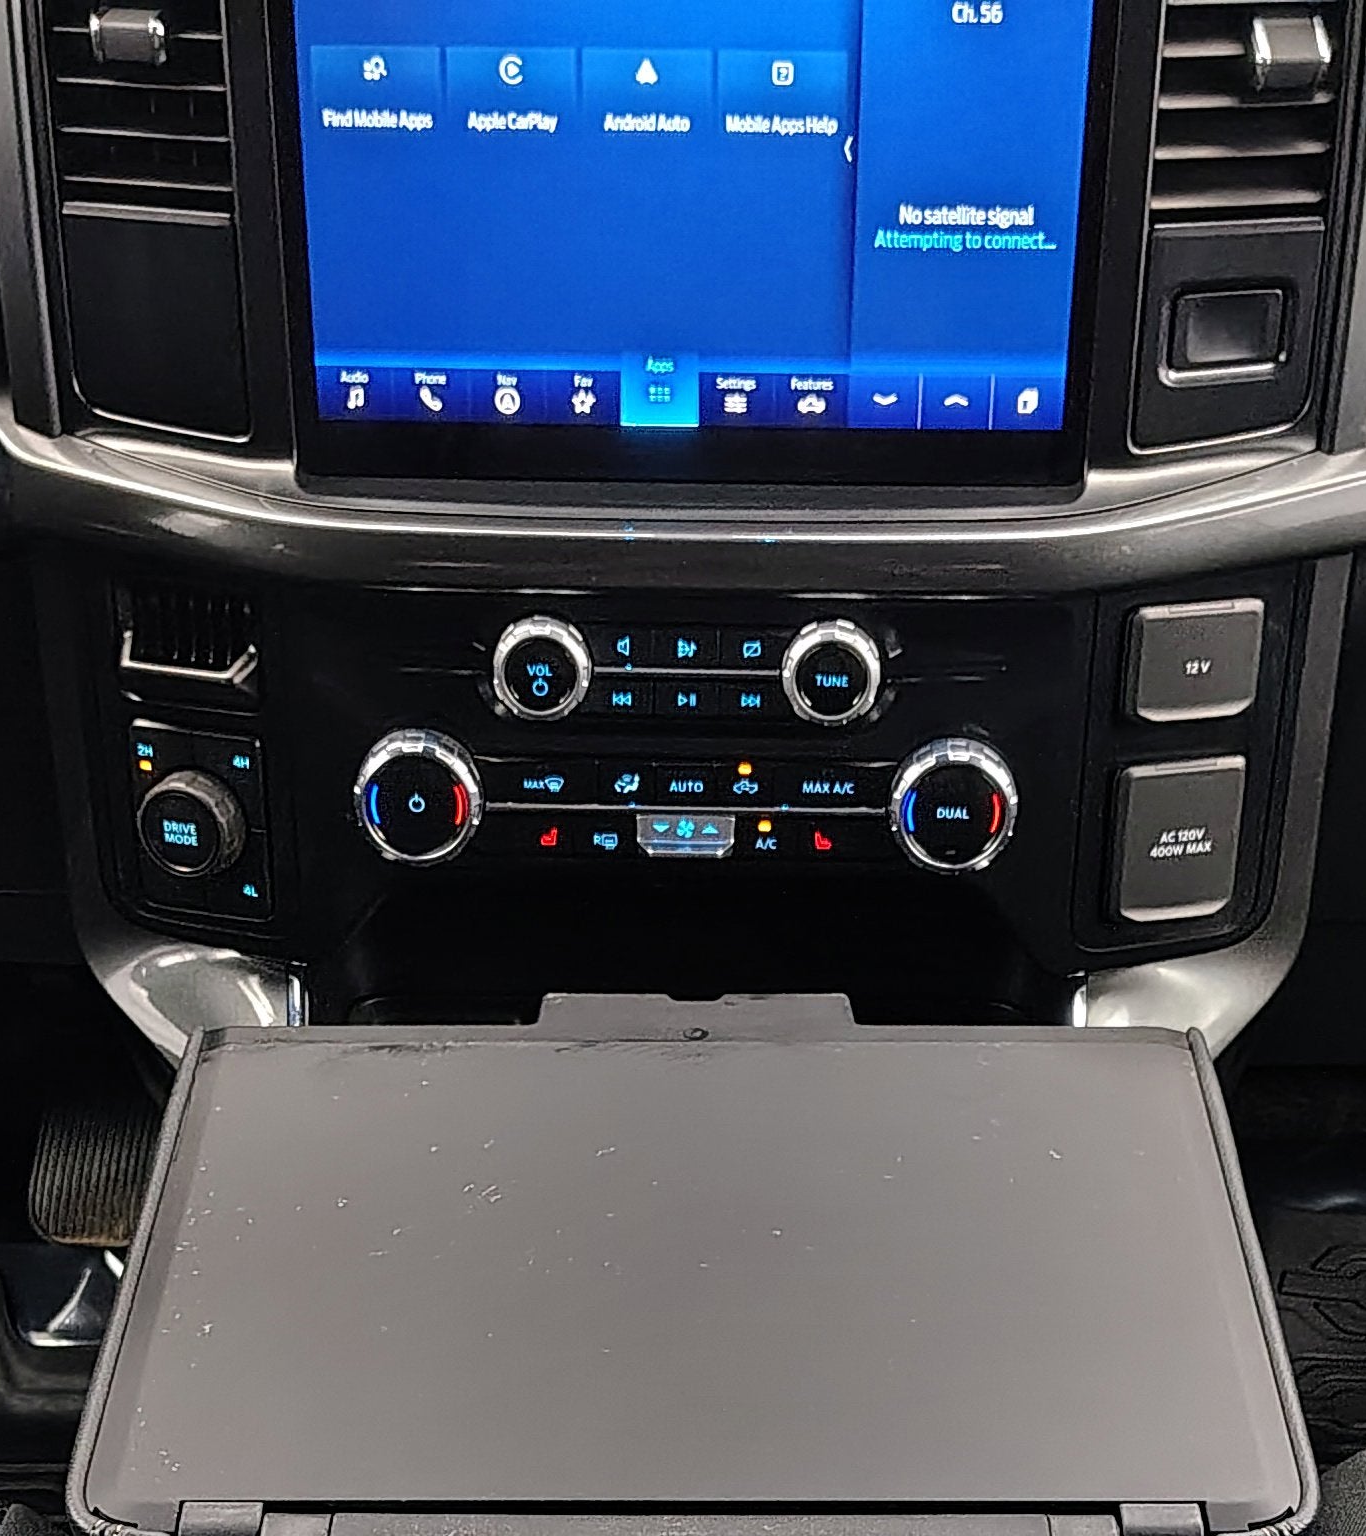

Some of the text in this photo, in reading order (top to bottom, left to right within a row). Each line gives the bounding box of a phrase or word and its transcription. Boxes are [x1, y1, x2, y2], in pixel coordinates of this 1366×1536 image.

[980, 2, 1003, 23] 56
[322, 109, 433, 131] Find Mobile Apps
[468, 111, 558, 134] Apple CarPlay
[604, 113, 690, 133] Android Auto
[726, 115, 838, 137] Mobile Apps Help
[899, 203, 1034, 228] No satellite signal
[874, 229, 962, 252] Attempting
[965, 231, 981, 248] to
[645, 356, 674, 374] Apps
[340, 370, 370, 383] Audio
[414, 371, 447, 384] Phone
[496, 373, 518, 386] Nav
[573, 374, 594, 387] Fav
[716, 376, 757, 391] Settings
[791, 376, 834, 391] Features
[527, 664, 553, 678] VOL
[815, 673, 850, 688] TUNE
[137, 743, 154, 758] 2H
[233, 755, 250, 770] 4H
[669, 779, 704, 793] AUTO
[802, 780, 855, 795] MAX A/C
[936, 806, 970, 820] DUAL
[163, 819, 198, 835] DRIVE
[164, 833, 199, 847] MODE
[755, 836, 778, 850] A/C
[1160, 827, 1206, 844] AC 120V
[1150, 841, 1212, 858] 400W MAX
[242, 884, 259, 898] 4L
